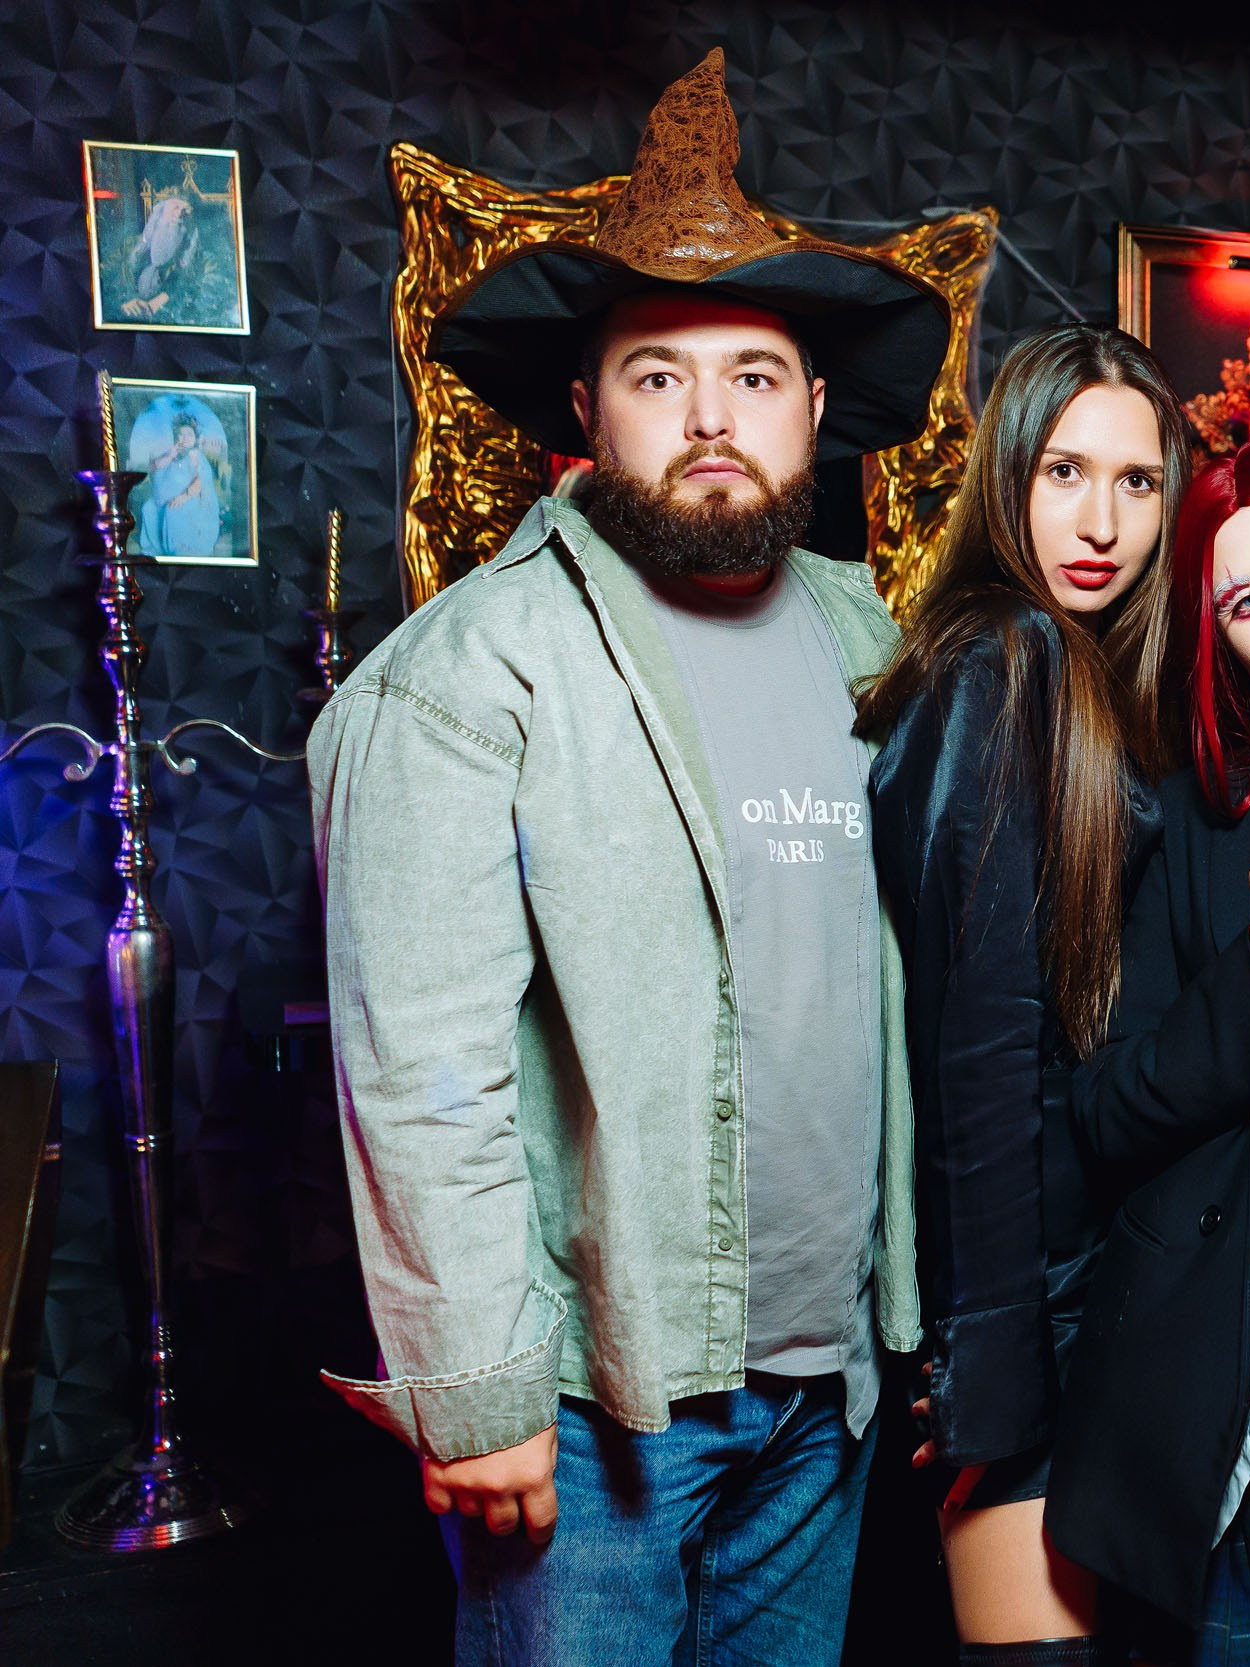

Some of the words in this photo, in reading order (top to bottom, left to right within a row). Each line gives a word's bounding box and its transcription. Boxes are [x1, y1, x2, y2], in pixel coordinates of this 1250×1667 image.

[741, 798, 778, 824] on
[779, 787, 864, 839] Marg
[766, 838, 825, 864] PARIS
